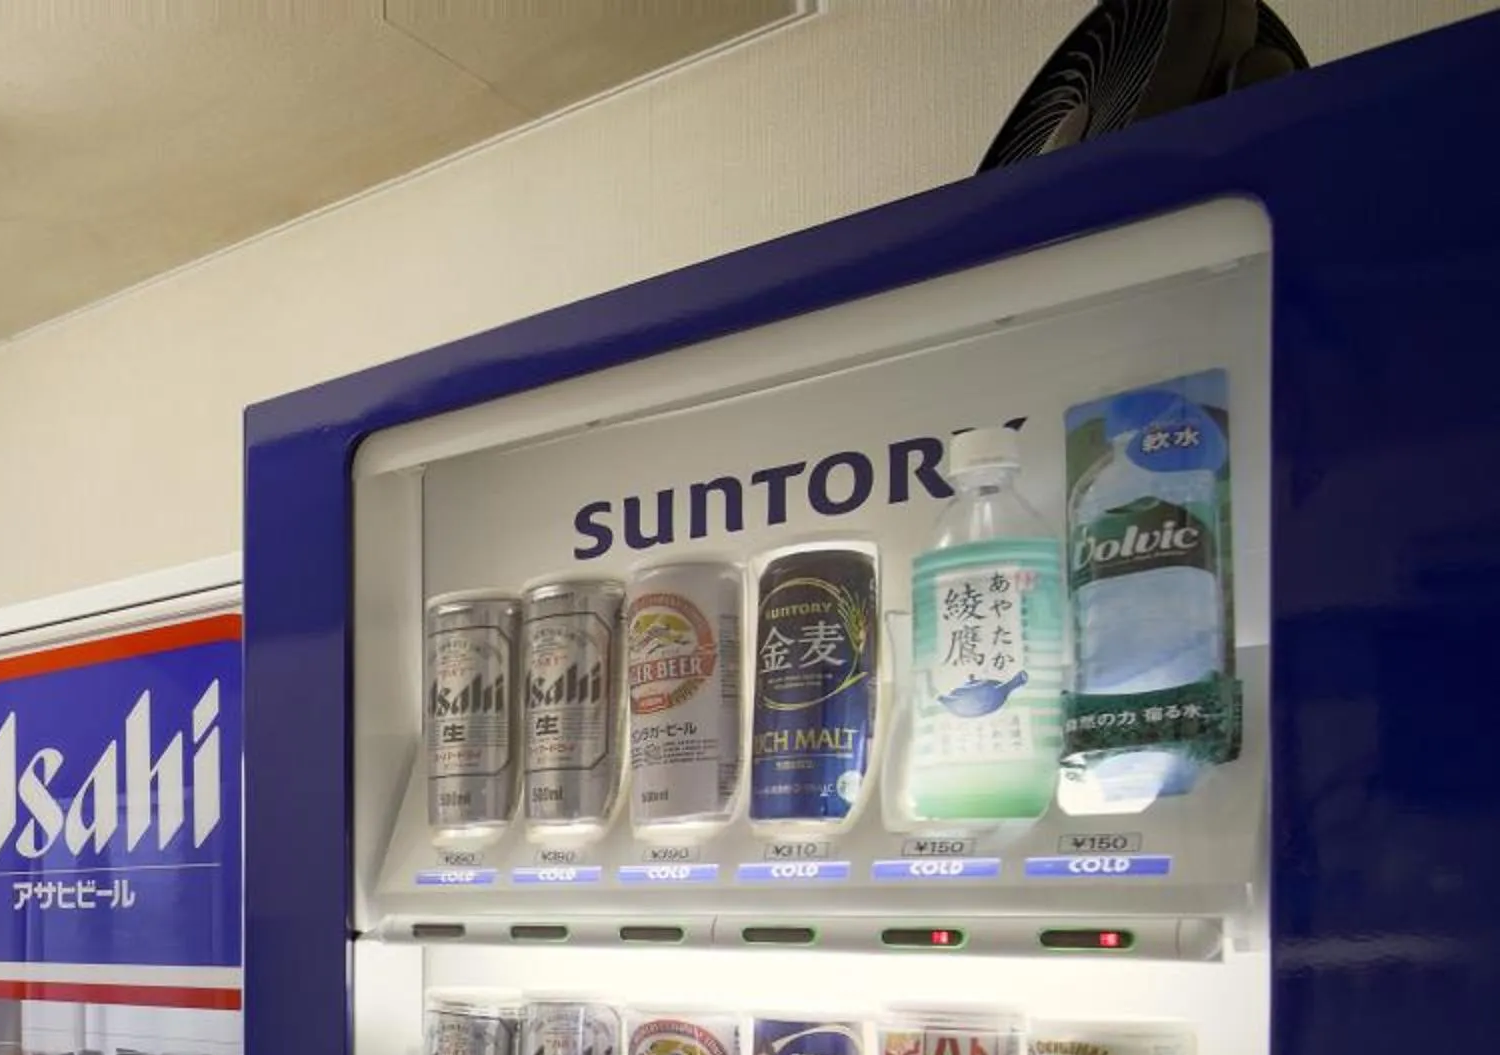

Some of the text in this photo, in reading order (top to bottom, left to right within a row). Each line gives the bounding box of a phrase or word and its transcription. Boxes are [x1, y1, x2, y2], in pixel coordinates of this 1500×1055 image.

[573, 416, 1028, 560] SUNTOR
[942, 582, 986, 668] 綾鷹
[988, 571, 1016, 671] あやたか
[759, 620, 847, 674] 金麦
[442, 721, 467, 744] 生
[535, 714, 560, 737] 生
[794, 726, 860, 753] MALT
[914, 839, 965, 855] ¥150
[1072, 836, 1129, 851] ¥150
[770, 862, 819, 878] COLD
[908, 860, 965, 876] COLD
[1067, 857, 1132, 874] COLD
[12, 879, 136, 910] アサヒビール
